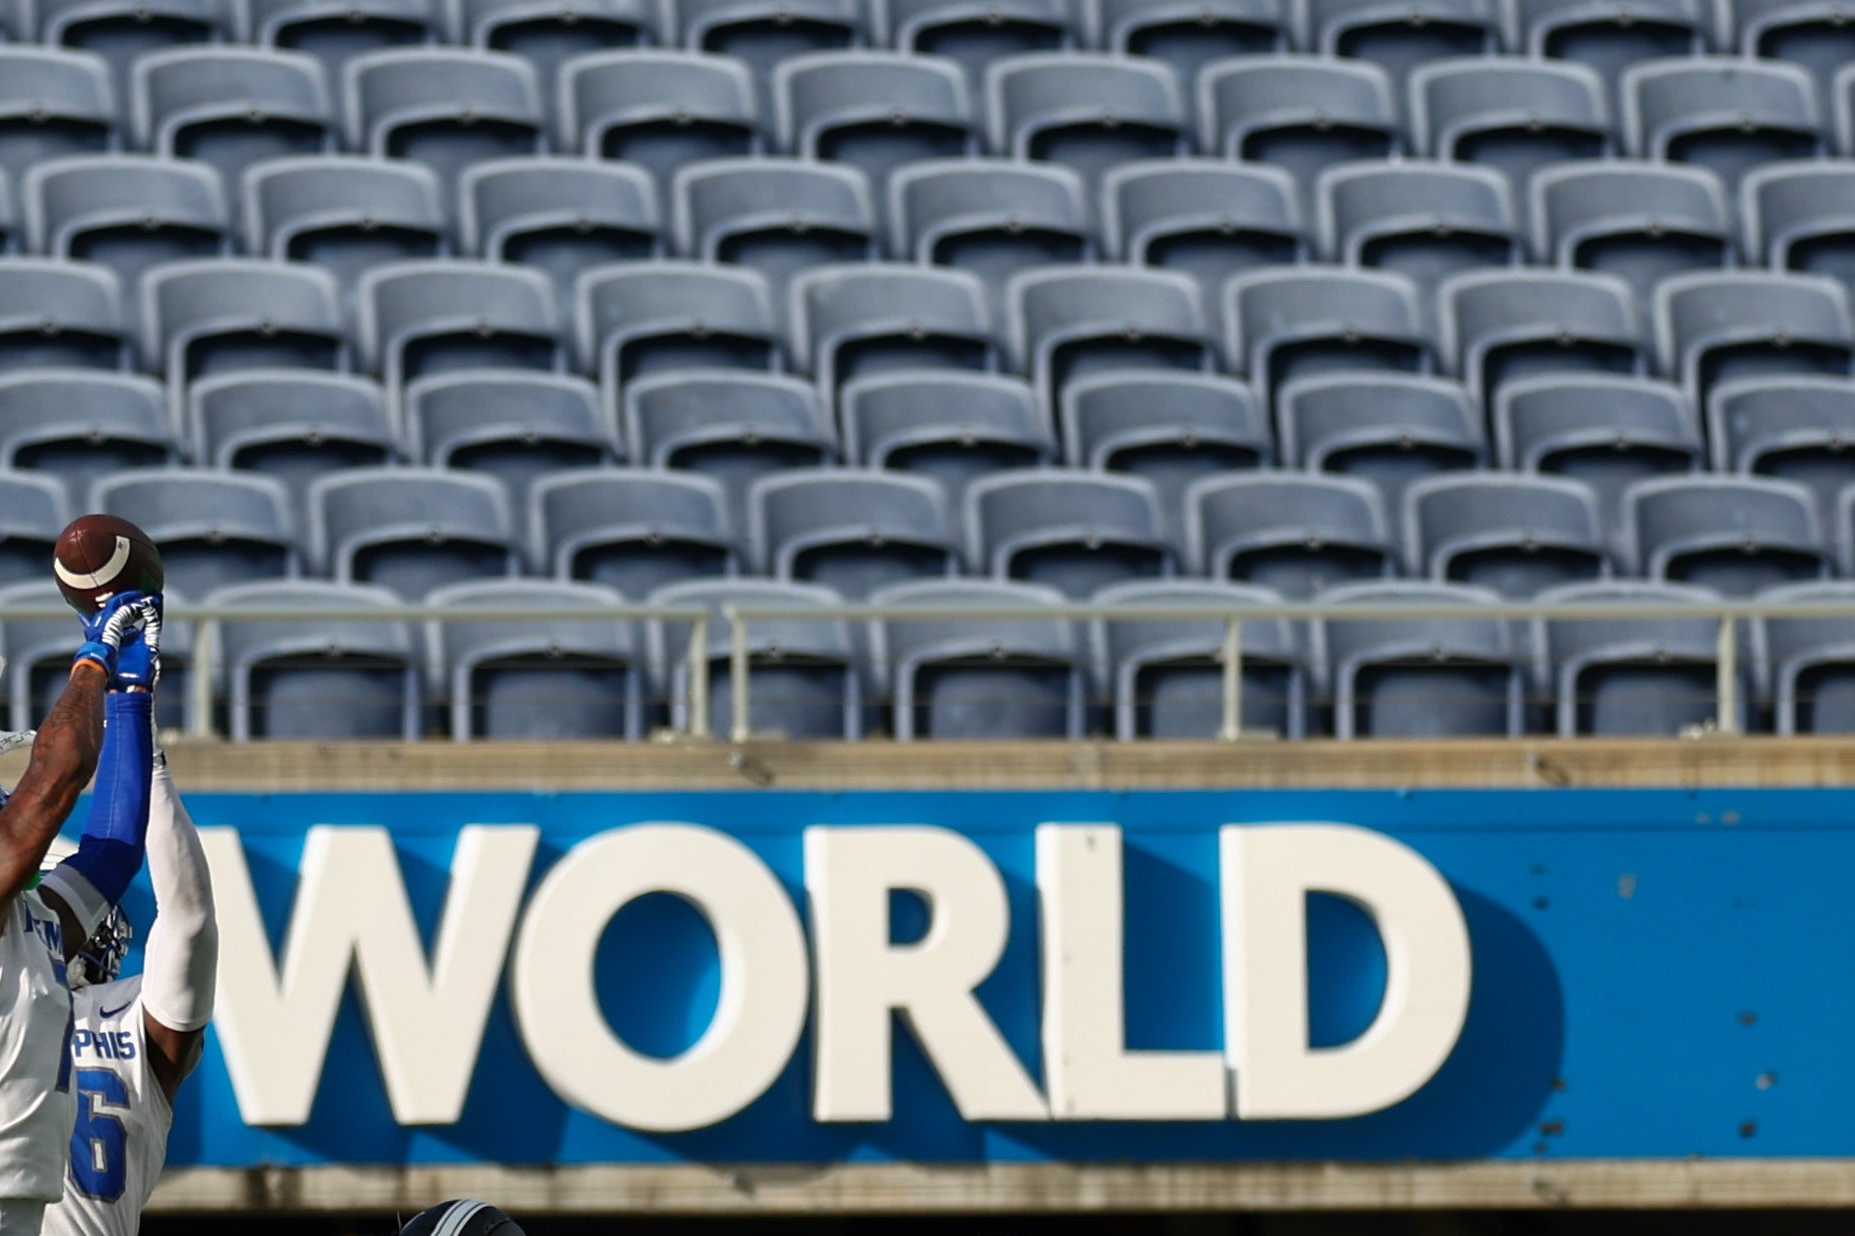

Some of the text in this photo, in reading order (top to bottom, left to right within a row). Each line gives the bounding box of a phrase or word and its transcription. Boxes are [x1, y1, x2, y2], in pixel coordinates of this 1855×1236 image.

[71, 1028, 137, 1061] PHIS
[202, 822, 1472, 1131] WORLD
[67, 1066, 133, 1206] 6
